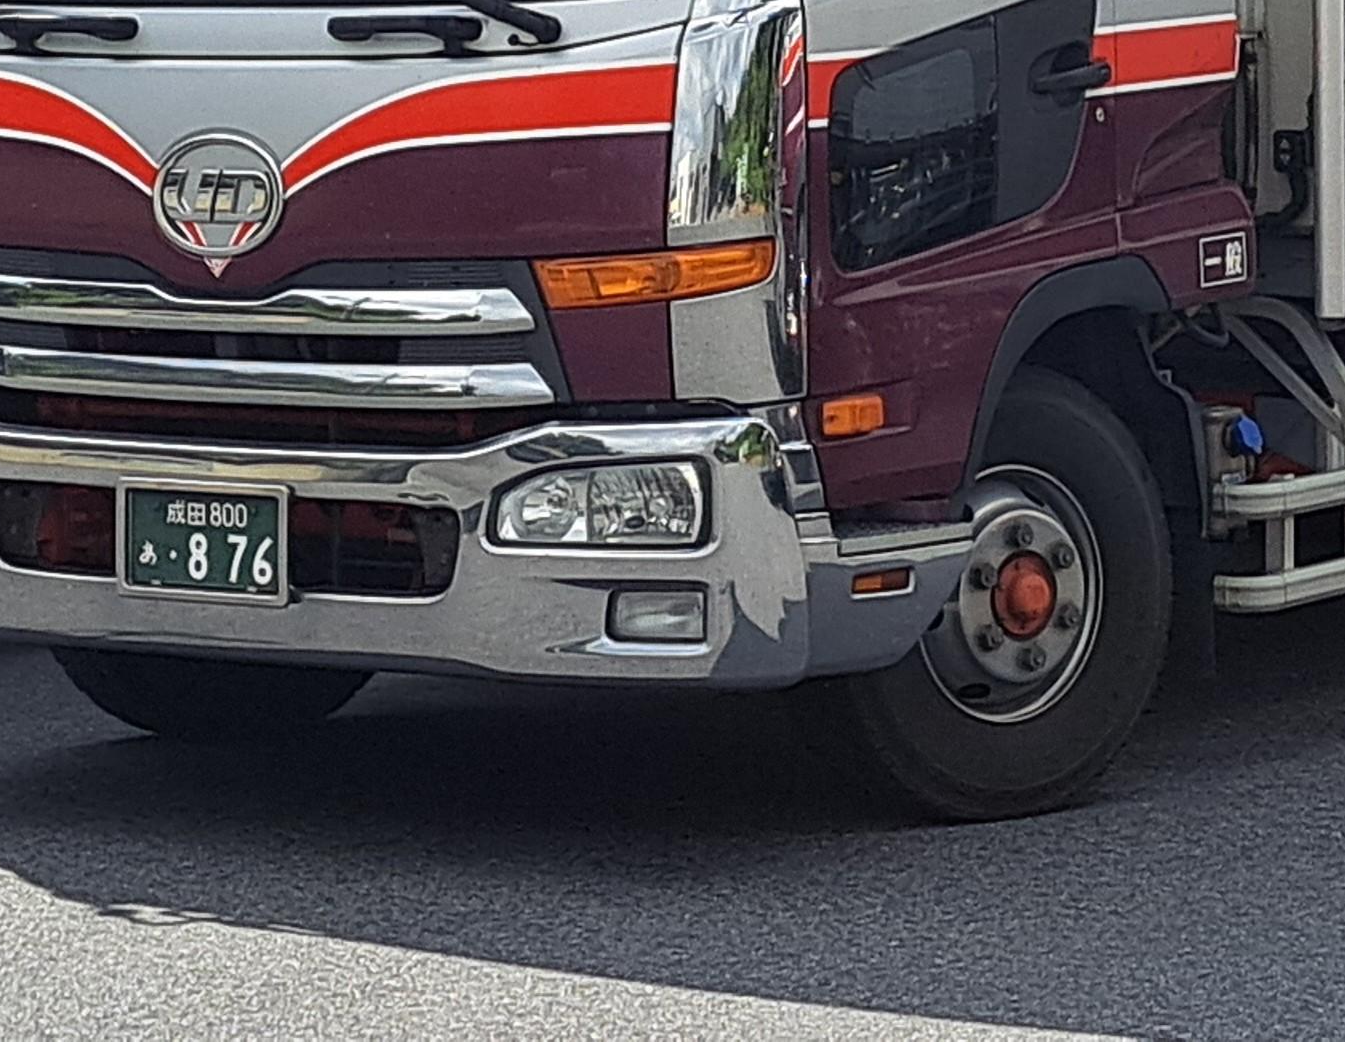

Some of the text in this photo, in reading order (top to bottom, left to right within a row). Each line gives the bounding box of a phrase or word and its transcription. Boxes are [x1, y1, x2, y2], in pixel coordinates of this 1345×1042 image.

[163, 168, 269, 223] UD
[1205, 241, 1242, 276] 一般
[209, 502, 248, 528] 800
